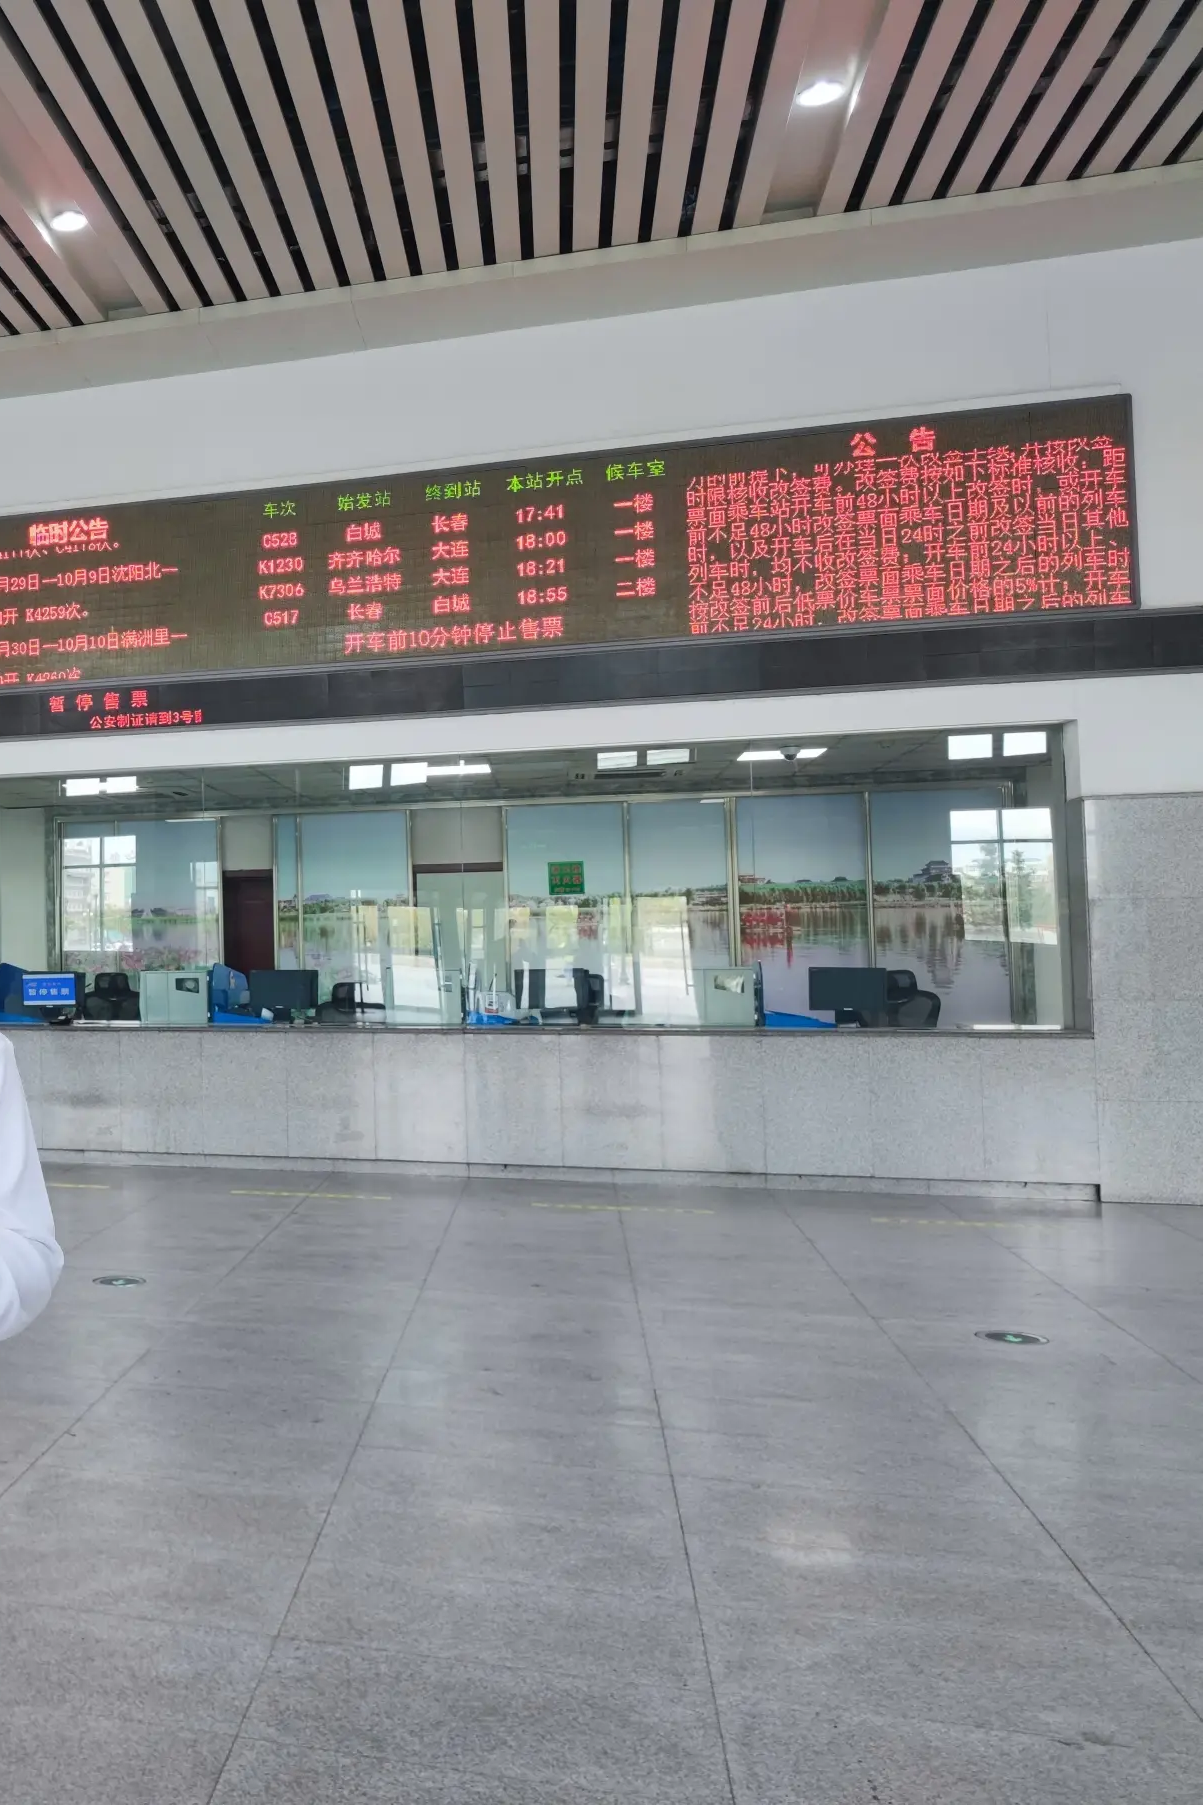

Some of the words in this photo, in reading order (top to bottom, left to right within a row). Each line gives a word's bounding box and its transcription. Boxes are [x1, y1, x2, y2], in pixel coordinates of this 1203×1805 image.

[850, 426, 936, 457] 公告
[263, 500, 296, 518] 车次
[338, 490, 391, 511] 始发站
[425, 480, 481, 501] 终到站
[507, 468, 583, 492] 本站开点
[606, 459, 666, 481] 候车室
[29, 517, 109, 546] 临时公告
[262, 532, 298, 549] C528
[346, 521, 382, 542] 白城
[432, 512, 468, 533] 长春
[516, 504, 565, 522] 17:41
[613, 492, 654, 513] 一楼
[258, 557, 304, 575] K1230
[328, 547, 400, 570] 齐齐哈尔
[432, 540, 469, 560] 大连
[516, 531, 566, 550] 18:00
[614, 521, 655, 541] 一楼
[258, 583, 305, 600] K7306
[328, 573, 401, 595] 乌兰浩特
[432, 566, 470, 586] 大连
[517, 558, 566, 577] 18:21
[615, 549, 655, 568] 一楼
[263, 611, 299, 627] C517
[347, 602, 383, 622] 长春
[433, 594, 470, 614] 白城
[518, 586, 567, 605] 18:55
[615, 577, 656, 597] 二楼
[344, 616, 564, 653] 开车前10分钟停止售票
[49, 690, 149, 713] 暂停售票
